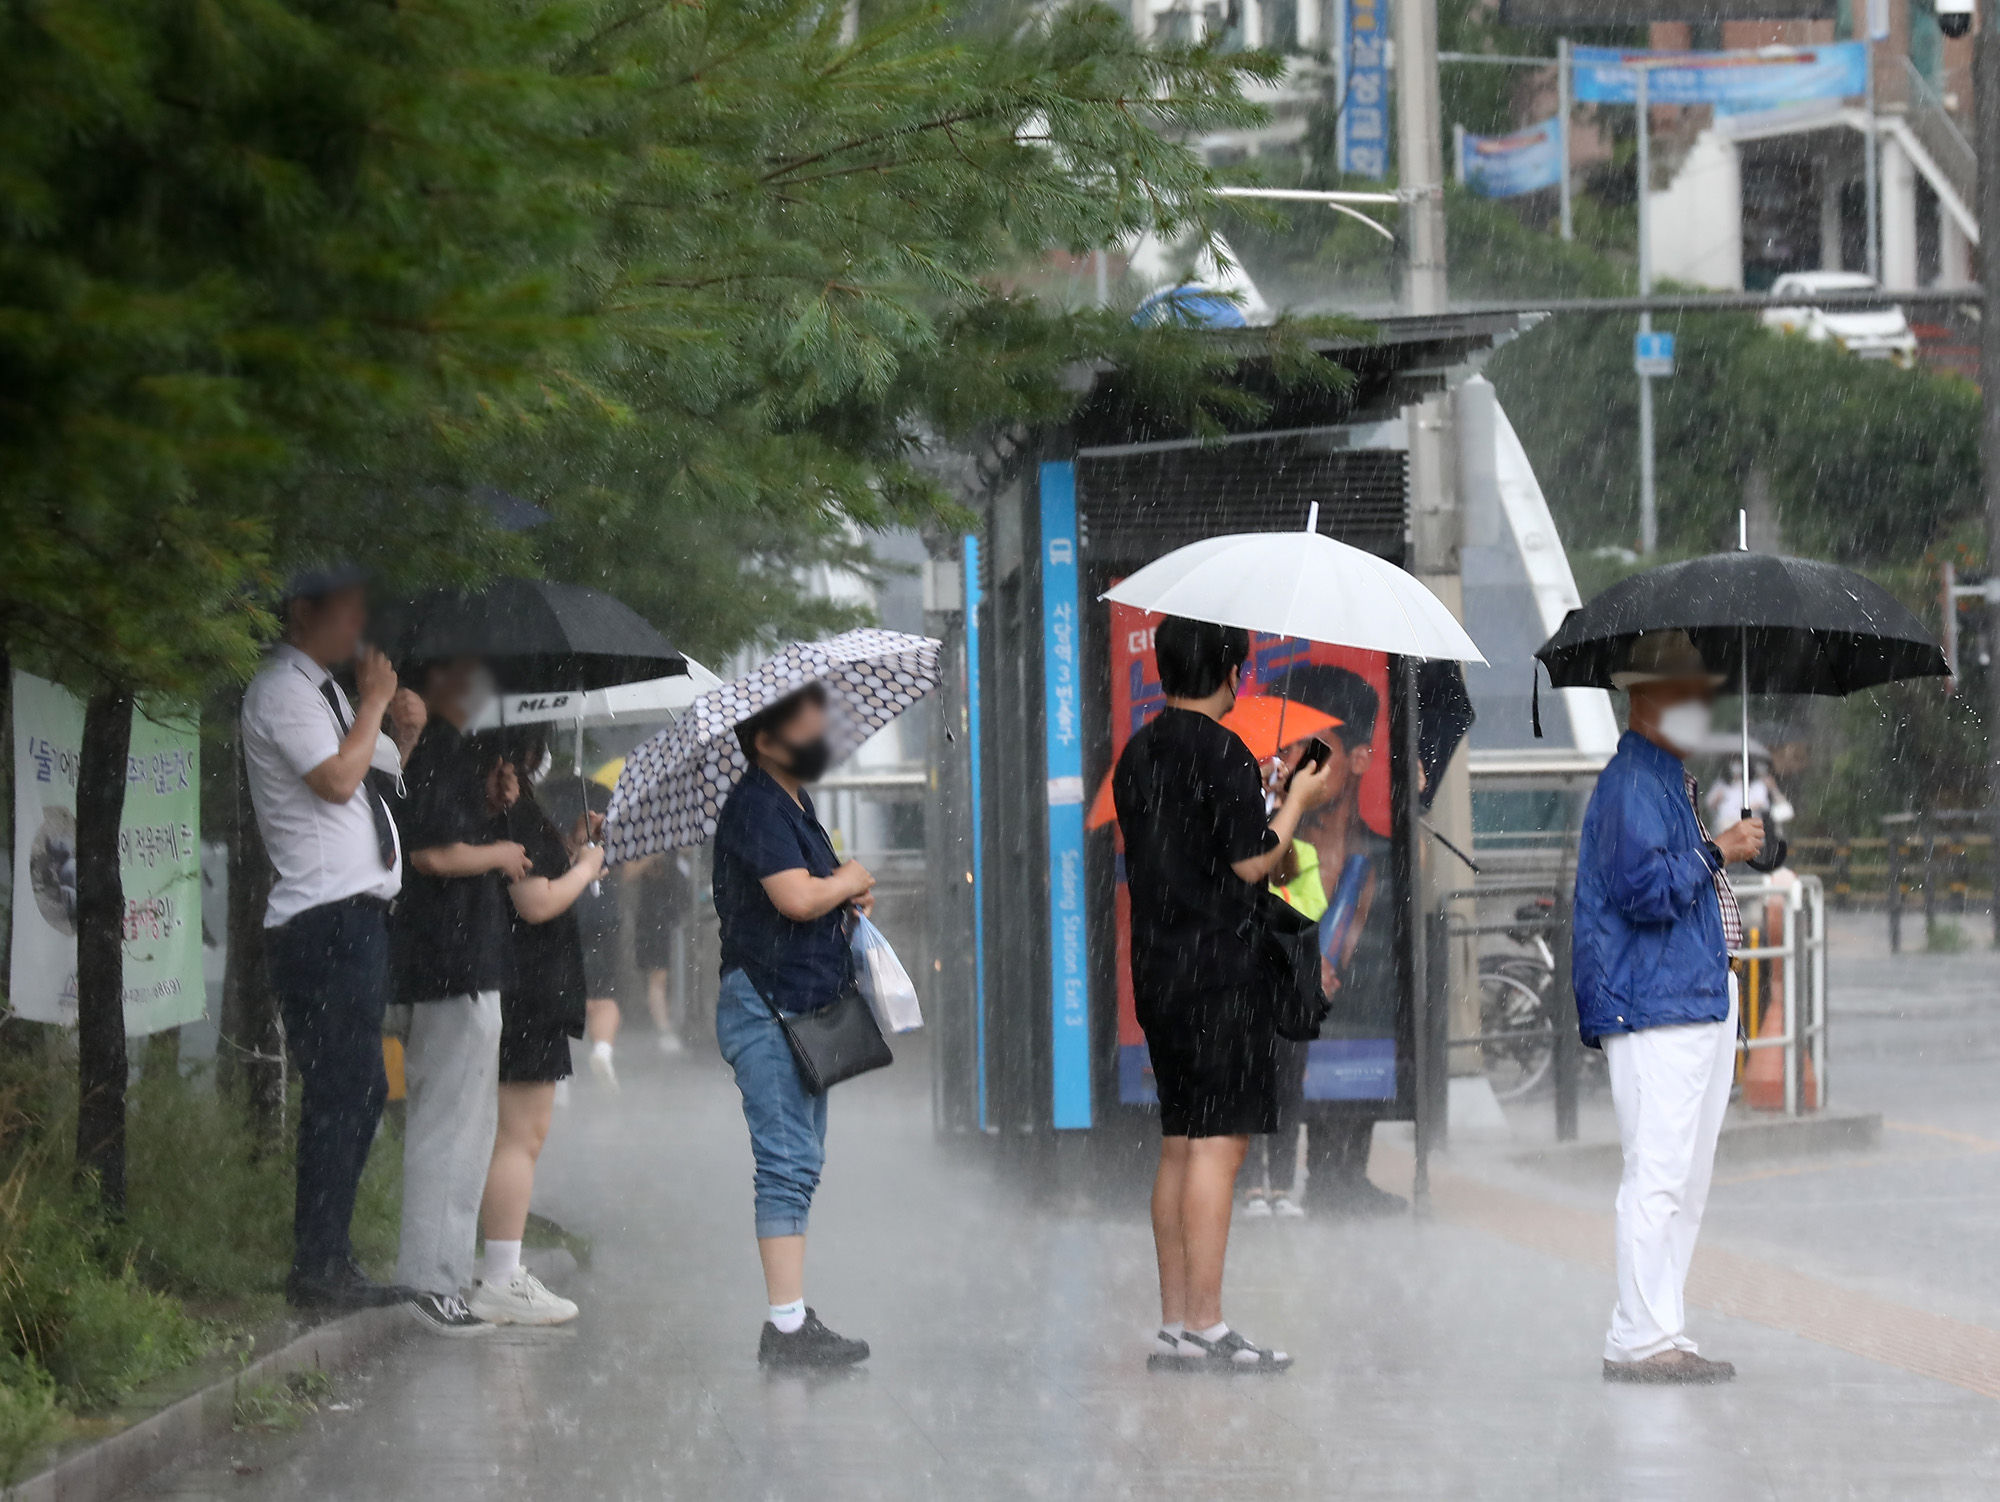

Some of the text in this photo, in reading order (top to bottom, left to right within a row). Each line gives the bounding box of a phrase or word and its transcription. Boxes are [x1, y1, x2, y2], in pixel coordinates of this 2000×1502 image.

[517, 694, 570, 713] MLB
[1058, 849, 1083, 1027] Sadang Station Exit 3
